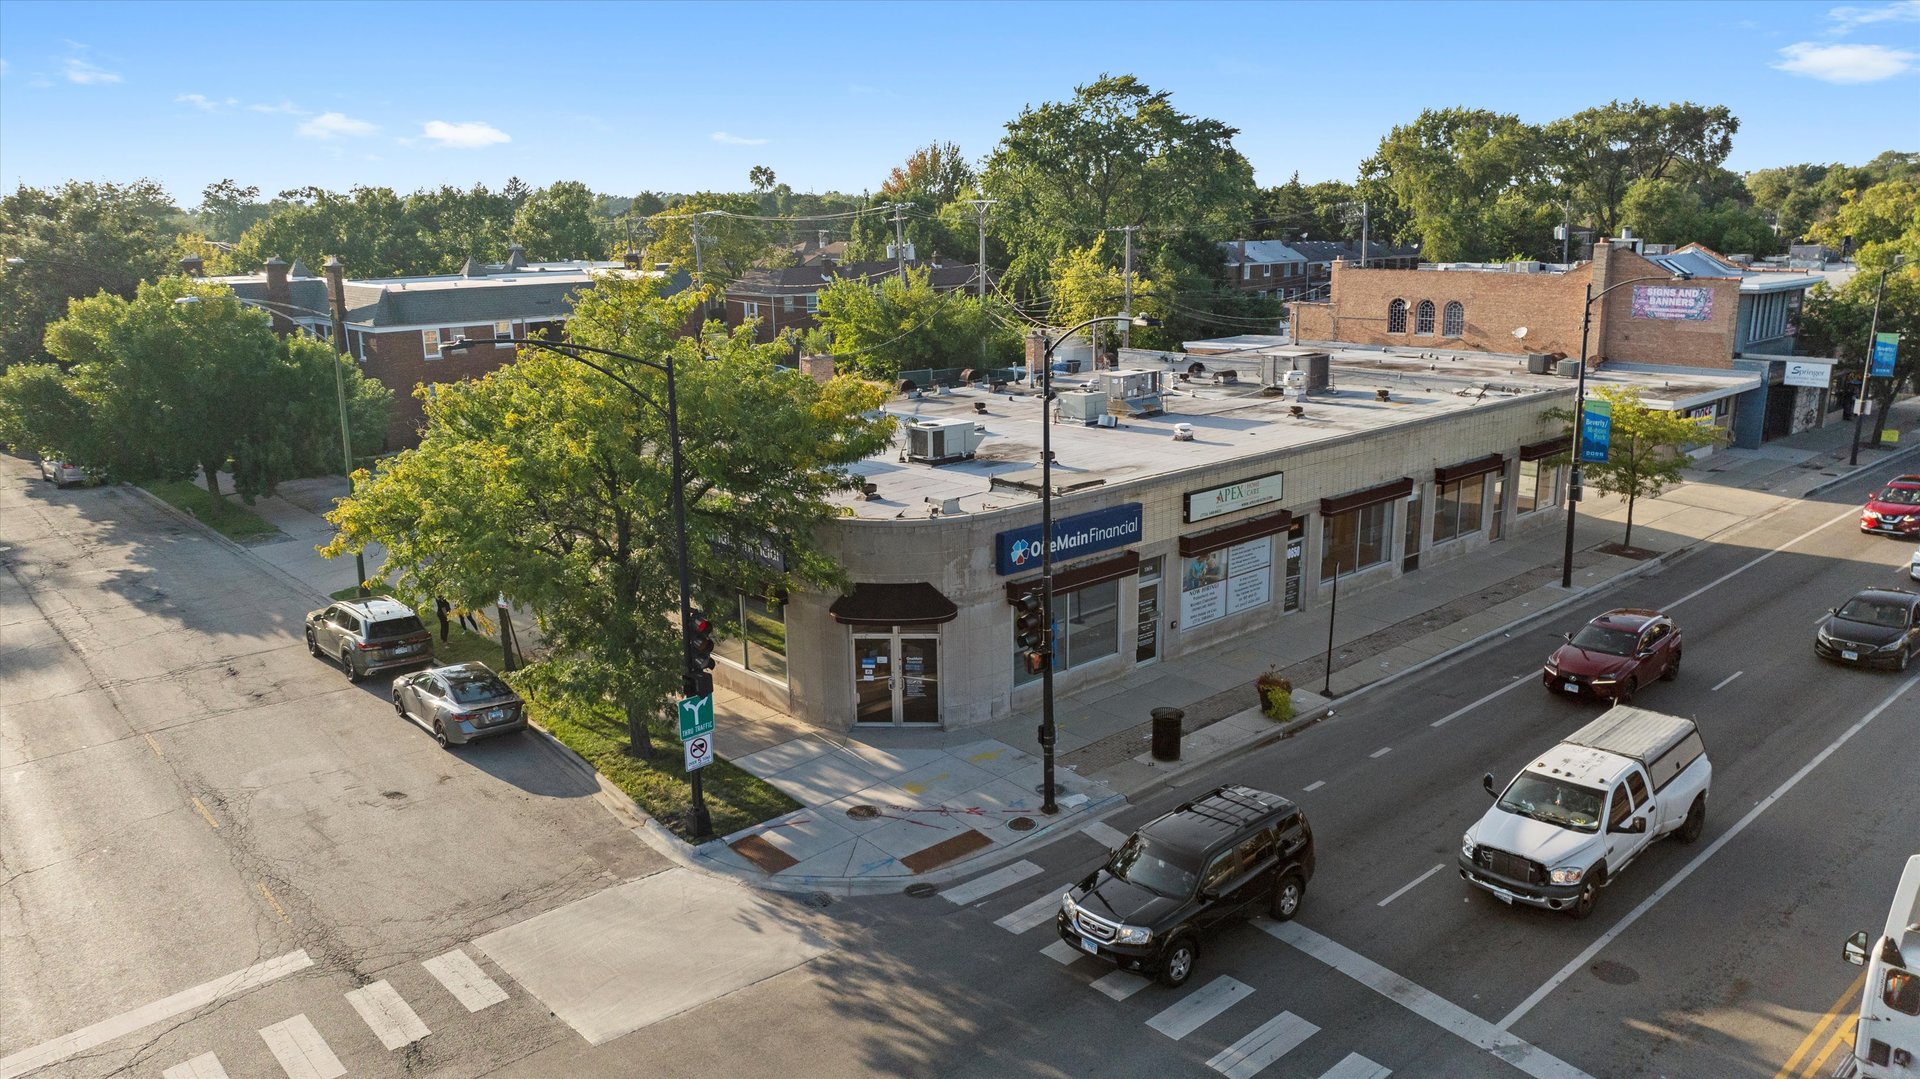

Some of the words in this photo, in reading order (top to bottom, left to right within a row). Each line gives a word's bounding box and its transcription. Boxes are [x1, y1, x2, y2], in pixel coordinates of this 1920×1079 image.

[1647, 287, 1677, 297] SIGNS
[1678, 288, 1699, 298] AND
[1649, 297, 1695, 307] BANNERS
[1791, 366, 1825, 377] Springer
[1216, 484, 1244, 504] APEX
[1246, 487, 1260, 497] CARE
[1030, 531, 1089, 557] OeMain
[682, 728, 694, 737] THRU
[695, 721, 713, 732] TRAFFIC
